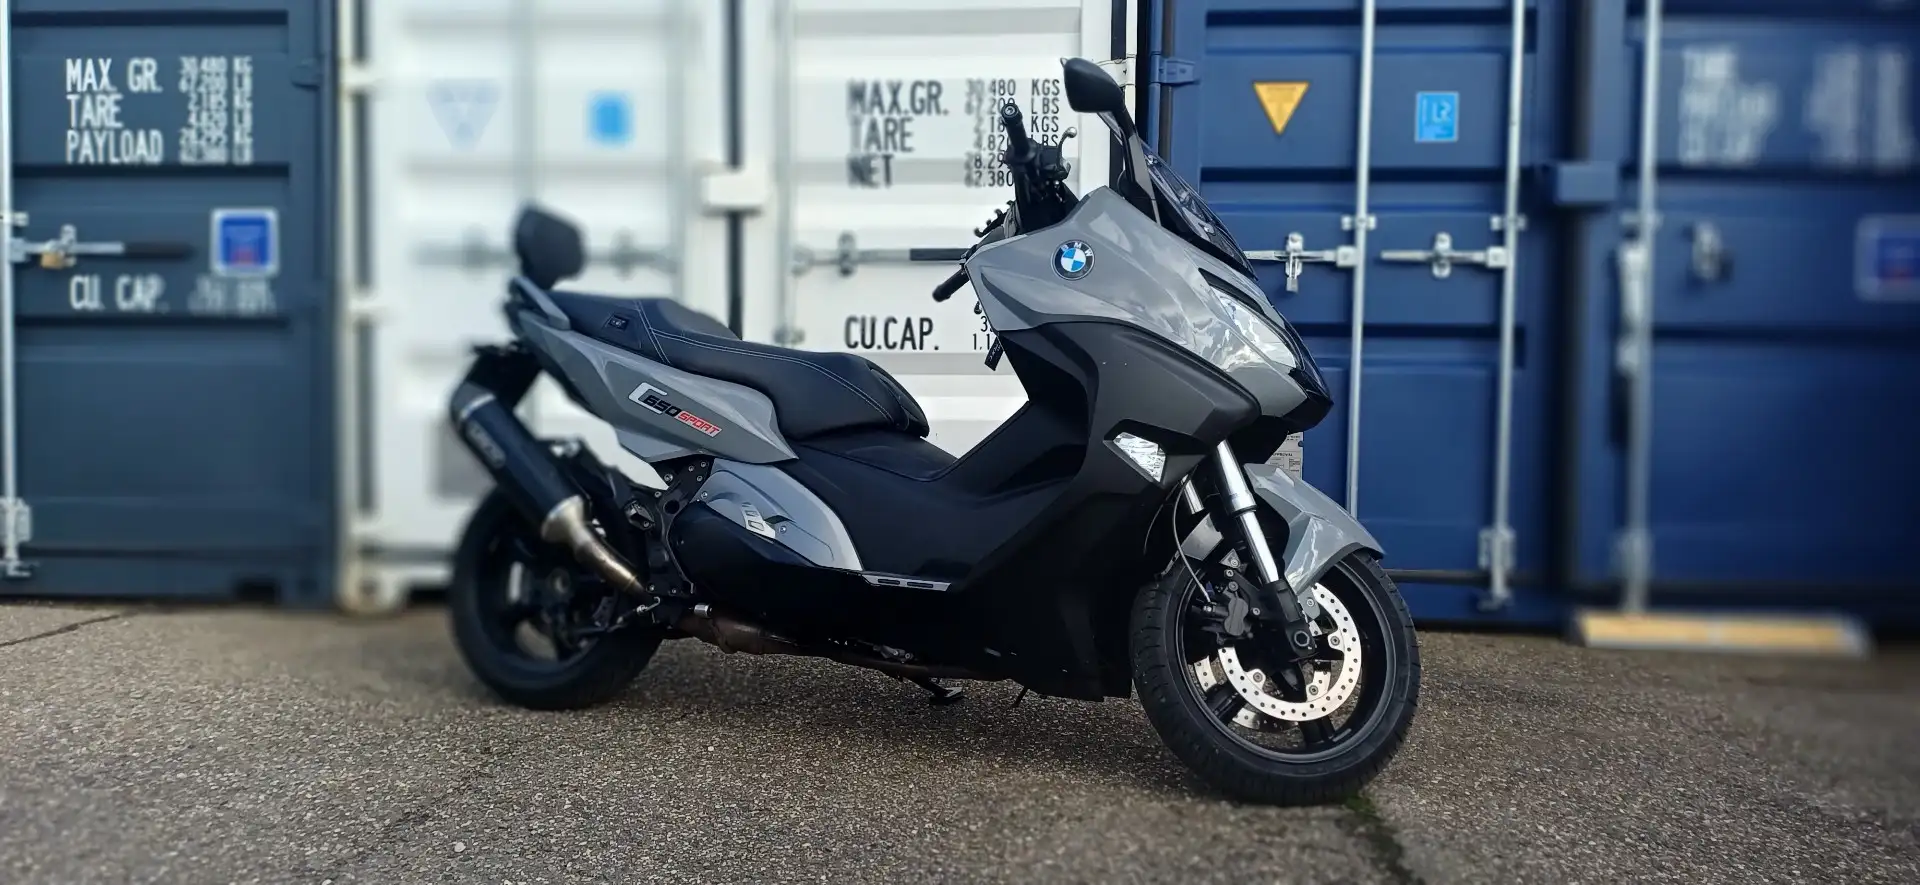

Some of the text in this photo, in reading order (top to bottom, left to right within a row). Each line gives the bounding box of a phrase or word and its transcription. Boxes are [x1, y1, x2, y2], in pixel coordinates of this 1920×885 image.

[127, 57, 163, 92] GR.
[66, 94, 124, 128] TARE
[847, 79, 949, 116] MAX.GR.
[1031, 79, 1060, 96] KGS
[1031, 97, 1059, 114] LBS
[66, 129, 164, 164] PAYLOAD
[848, 116, 915, 153] TARE
[1031, 116, 1059, 133] KGS
[1061, 241, 1093, 257] BMW
[844, 315, 939, 351] CU.CAP.
[675, 410, 721, 437] SPORT
